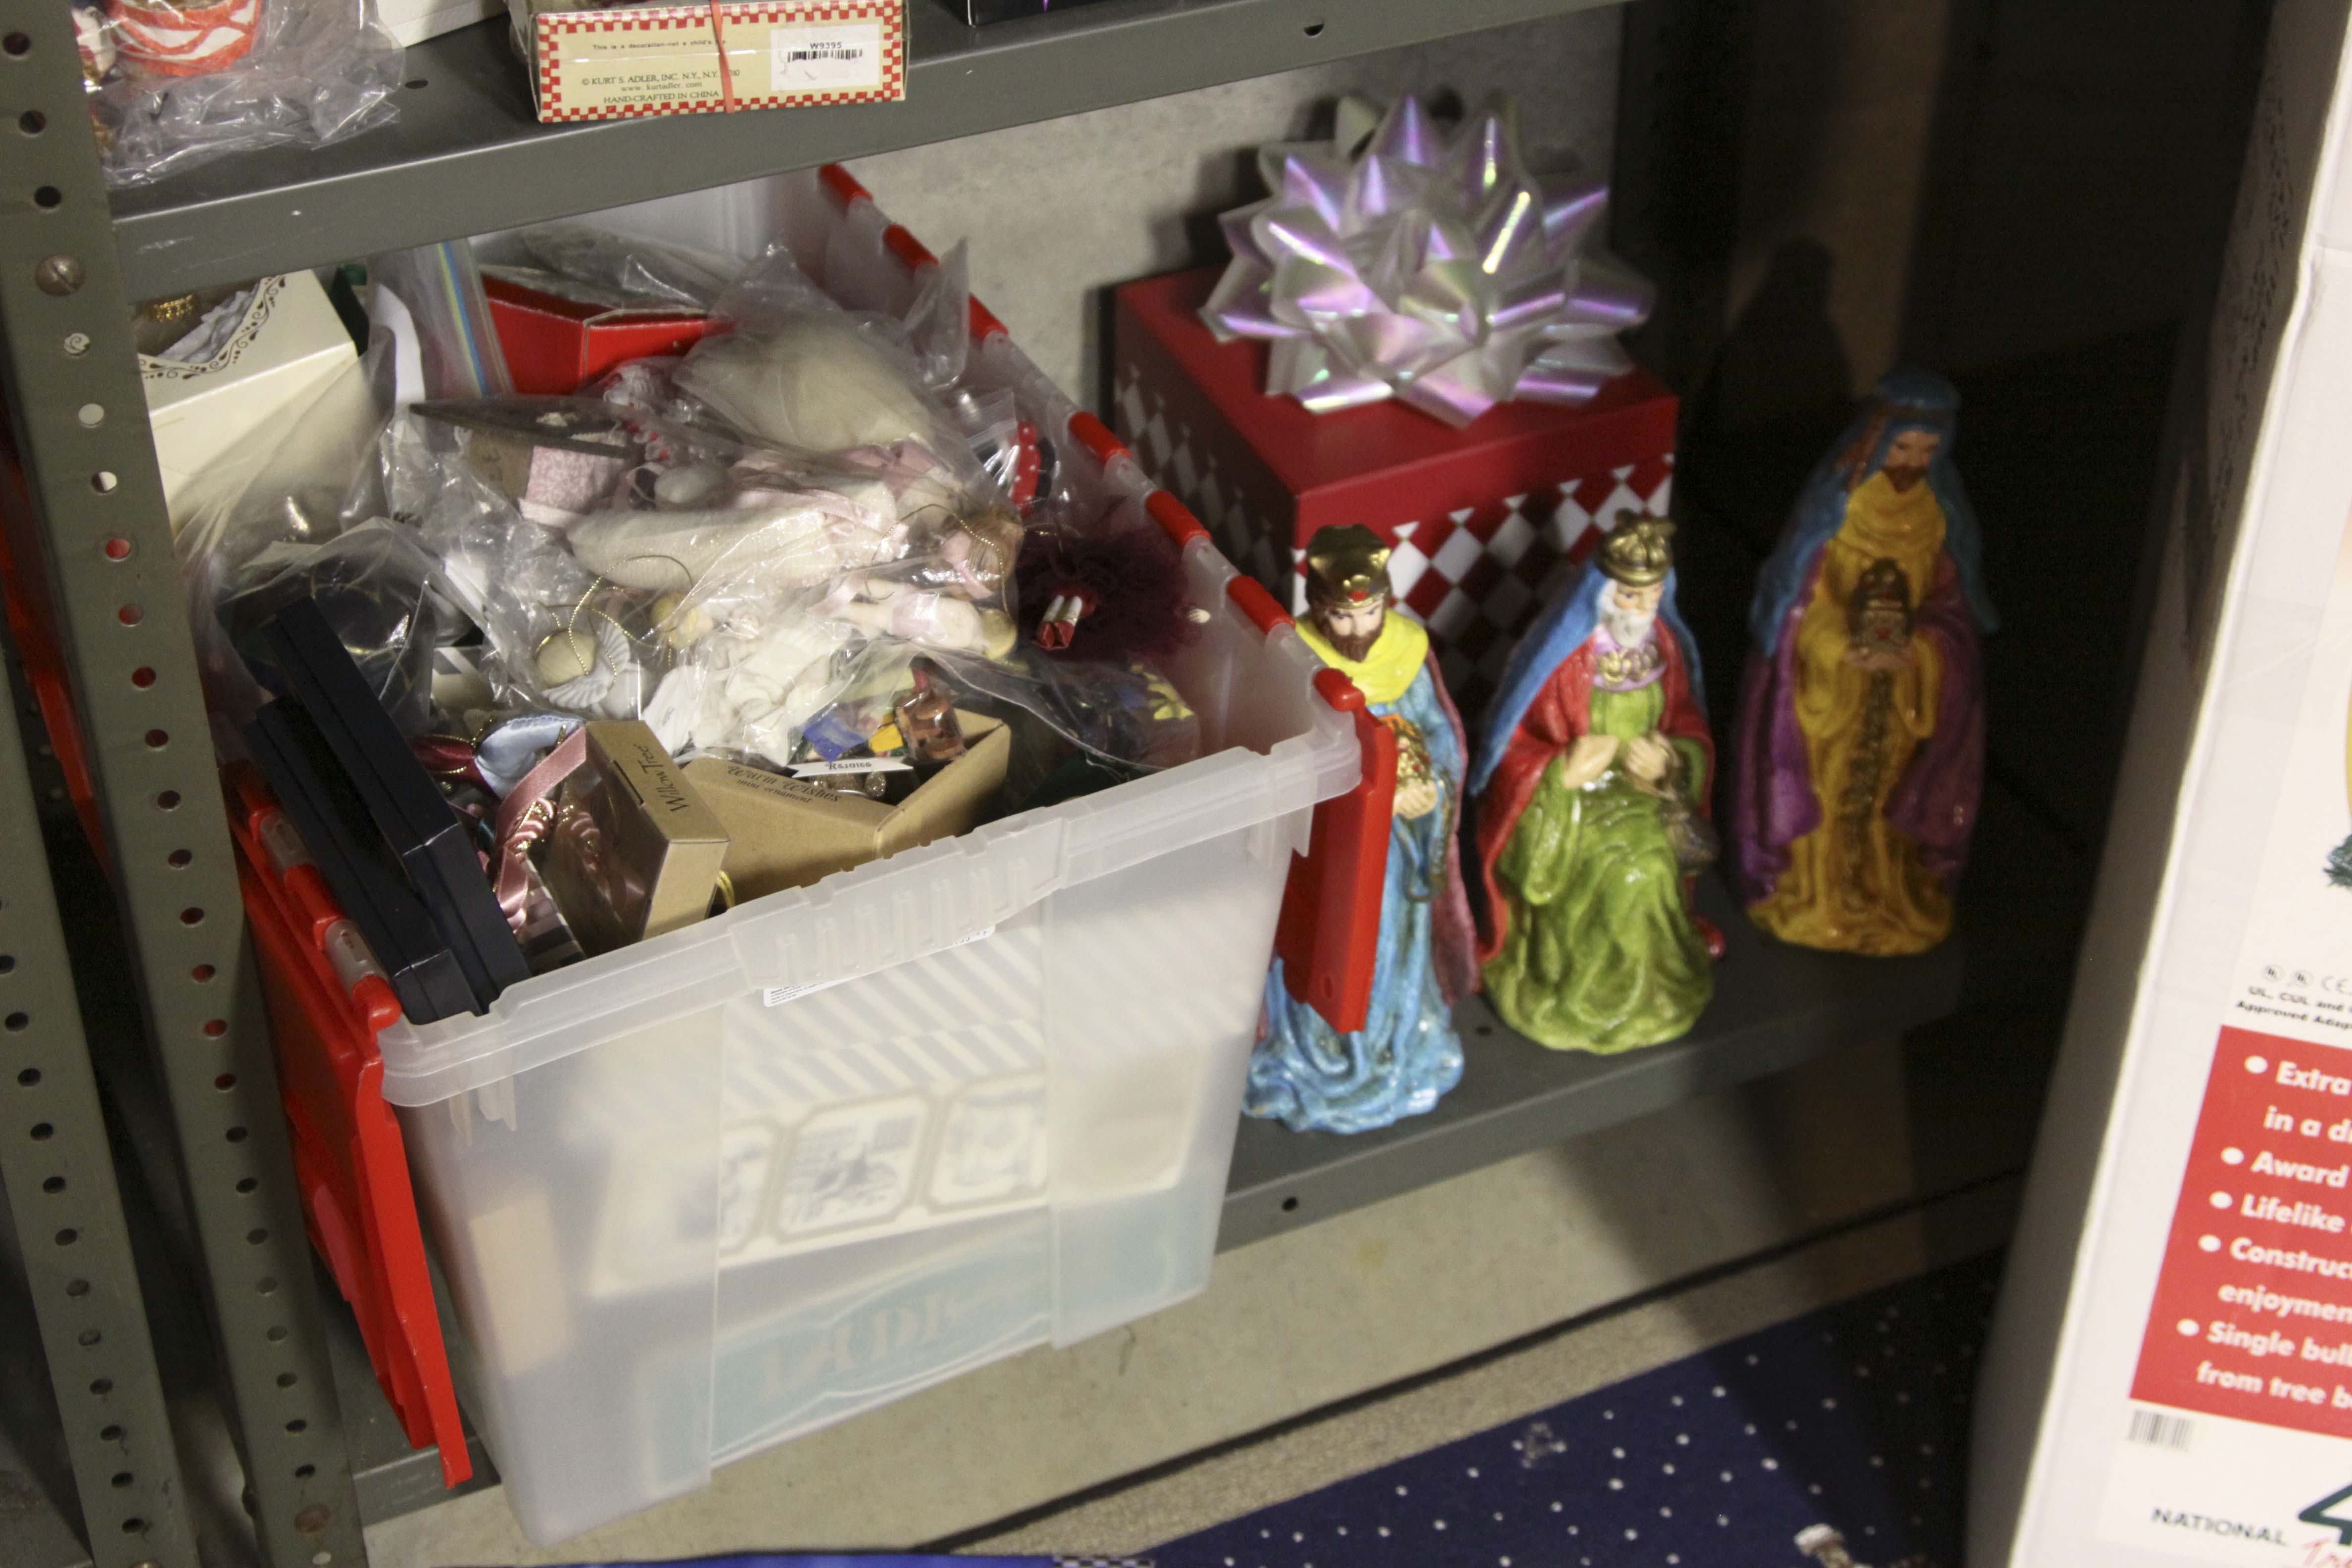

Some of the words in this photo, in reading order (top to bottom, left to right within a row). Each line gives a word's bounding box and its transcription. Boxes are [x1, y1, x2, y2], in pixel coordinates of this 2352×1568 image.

[591, 76, 616, 85] KURT
[627, 74, 660, 83] ADLER,
[661, 73, 679, 81] INC.
[655, 770, 690, 811] Willow
[736, 779, 760, 789] mini
[764, 786, 813, 803] ornament
[2236, 1000, 2309, 1021] Approved
[2316, 1001, 2345, 1012] and
[2275, 1060, 2352, 1096] Extra
[2263, 1104, 2294, 1133] in
[2299, 1118, 2322, 1137] a
[2250, 1150, 2351, 1188] Award
[2240, 1192, 2346, 1233] Lifelike
[2229, 1236, 2352, 1279] Construc
[2217, 1283, 2352, 1324] enjoymen
[2206, 1320, 2296, 1357] Single
[2196, 1360, 2263, 1394] from
[2268, 1376, 2327, 1405] tree
[2151, 1507, 2289, 1548] NATIONAL
